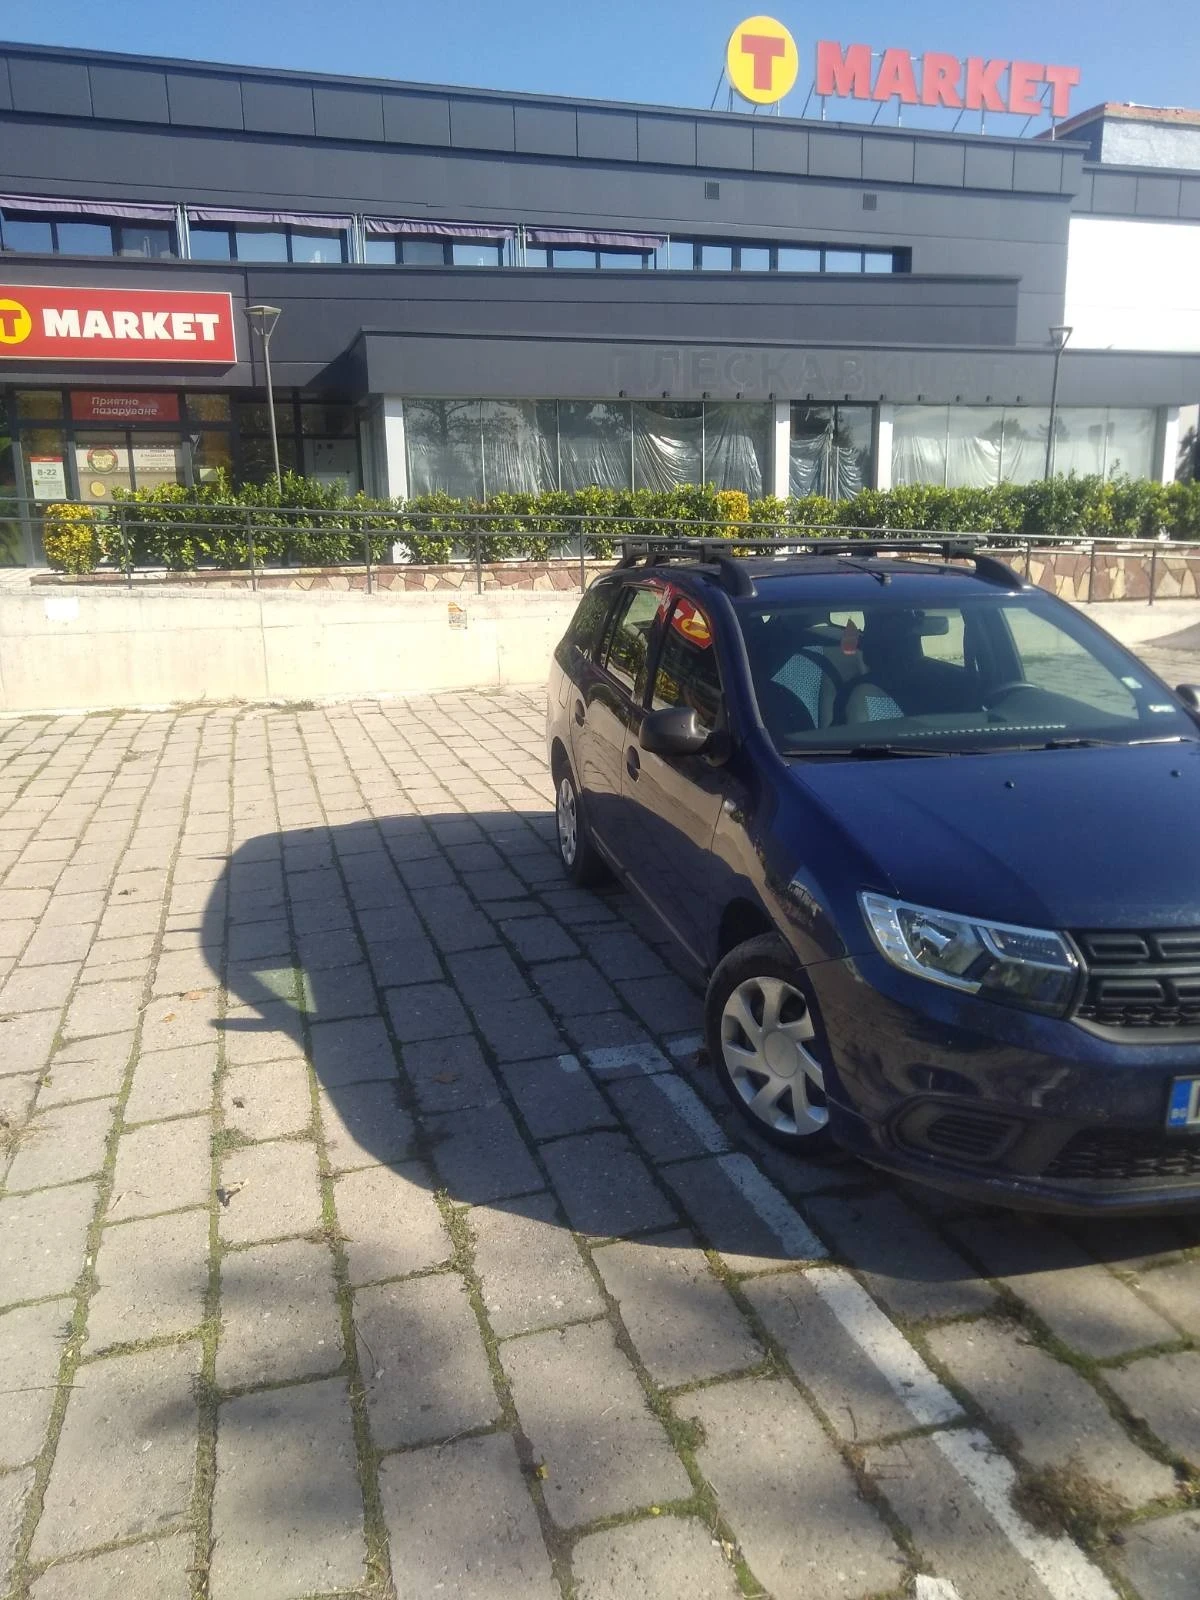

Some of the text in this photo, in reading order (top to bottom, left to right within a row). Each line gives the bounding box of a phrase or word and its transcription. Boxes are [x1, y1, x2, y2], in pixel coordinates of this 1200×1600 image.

[740, 34, 1081, 118] T MARKET
[0, 308, 220, 341] T MARKET
[91, 396, 140, 407] Приятно
[92, 406, 158, 417] пазаруване
